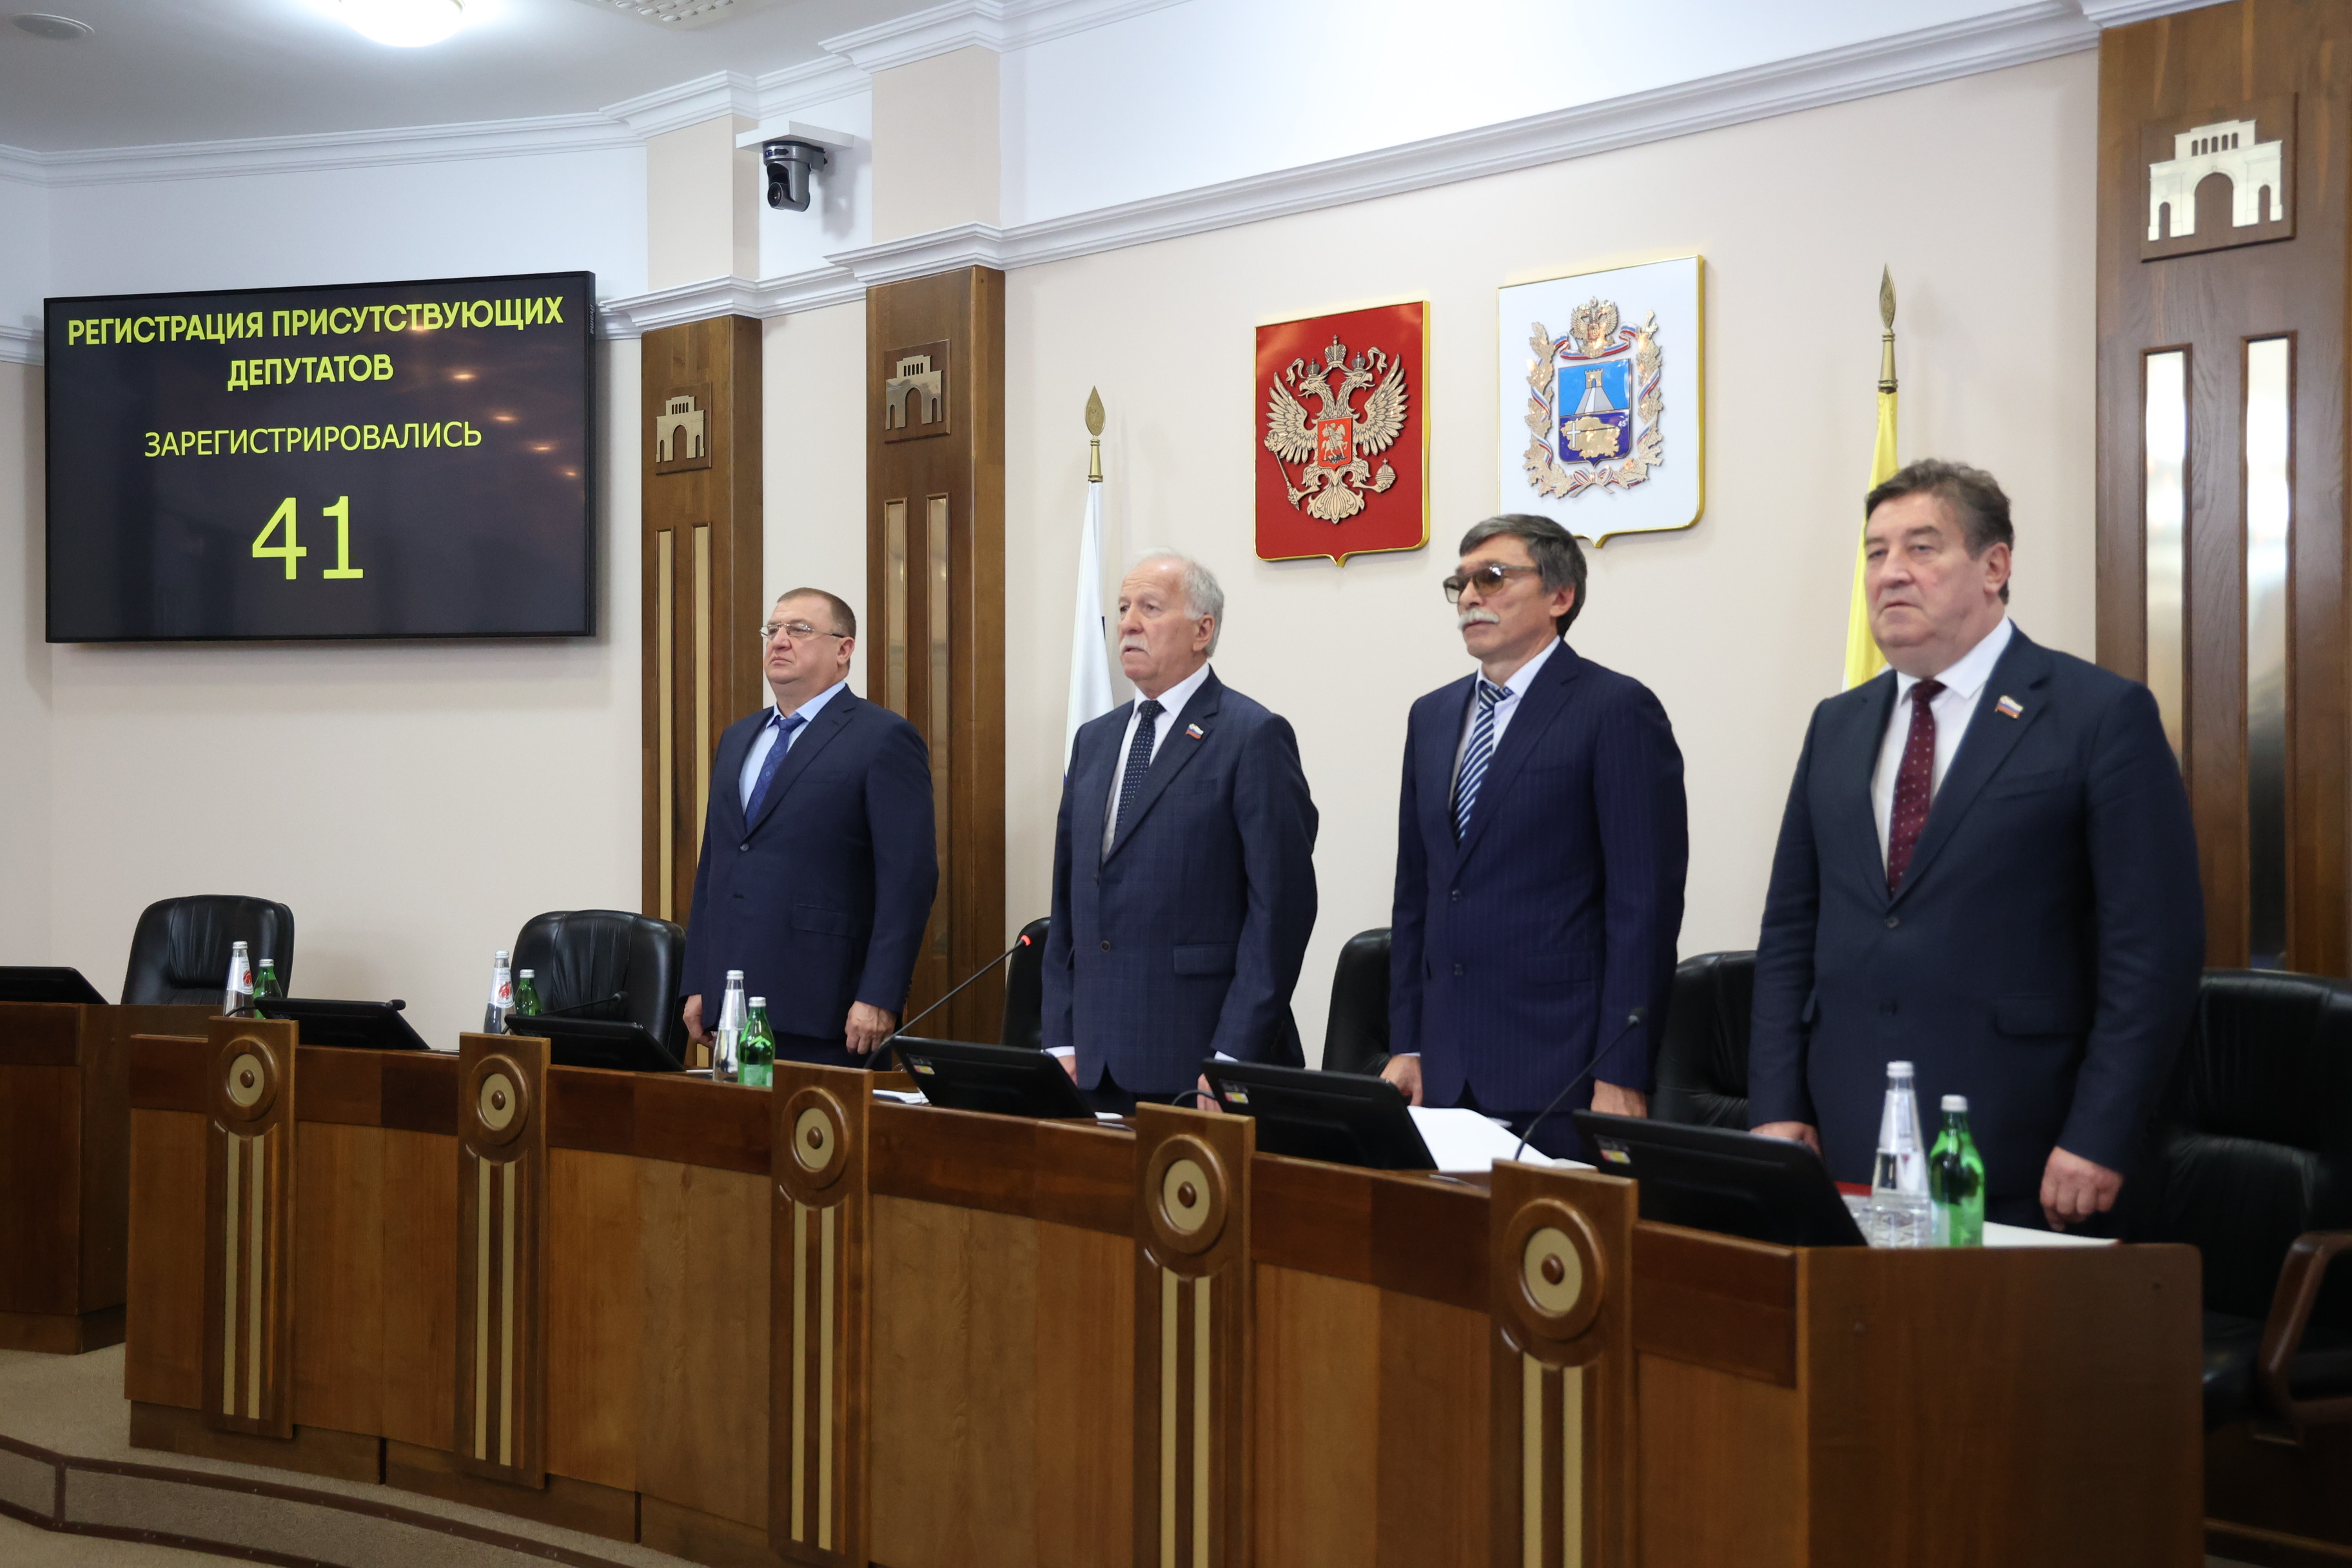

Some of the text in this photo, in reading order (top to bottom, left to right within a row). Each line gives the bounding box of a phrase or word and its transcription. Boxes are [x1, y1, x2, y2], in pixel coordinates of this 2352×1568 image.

[68, 296, 564, 345] РЕГИСТРАЦИЯ ПРИСУТСТВУЮЩИХ
[228, 354, 394, 391] ДЕПУТАТОВ
[144, 421, 482, 457] ЗАРЕГИСТРИРОВАЛИСЬ
[252, 495, 364, 580] 41
